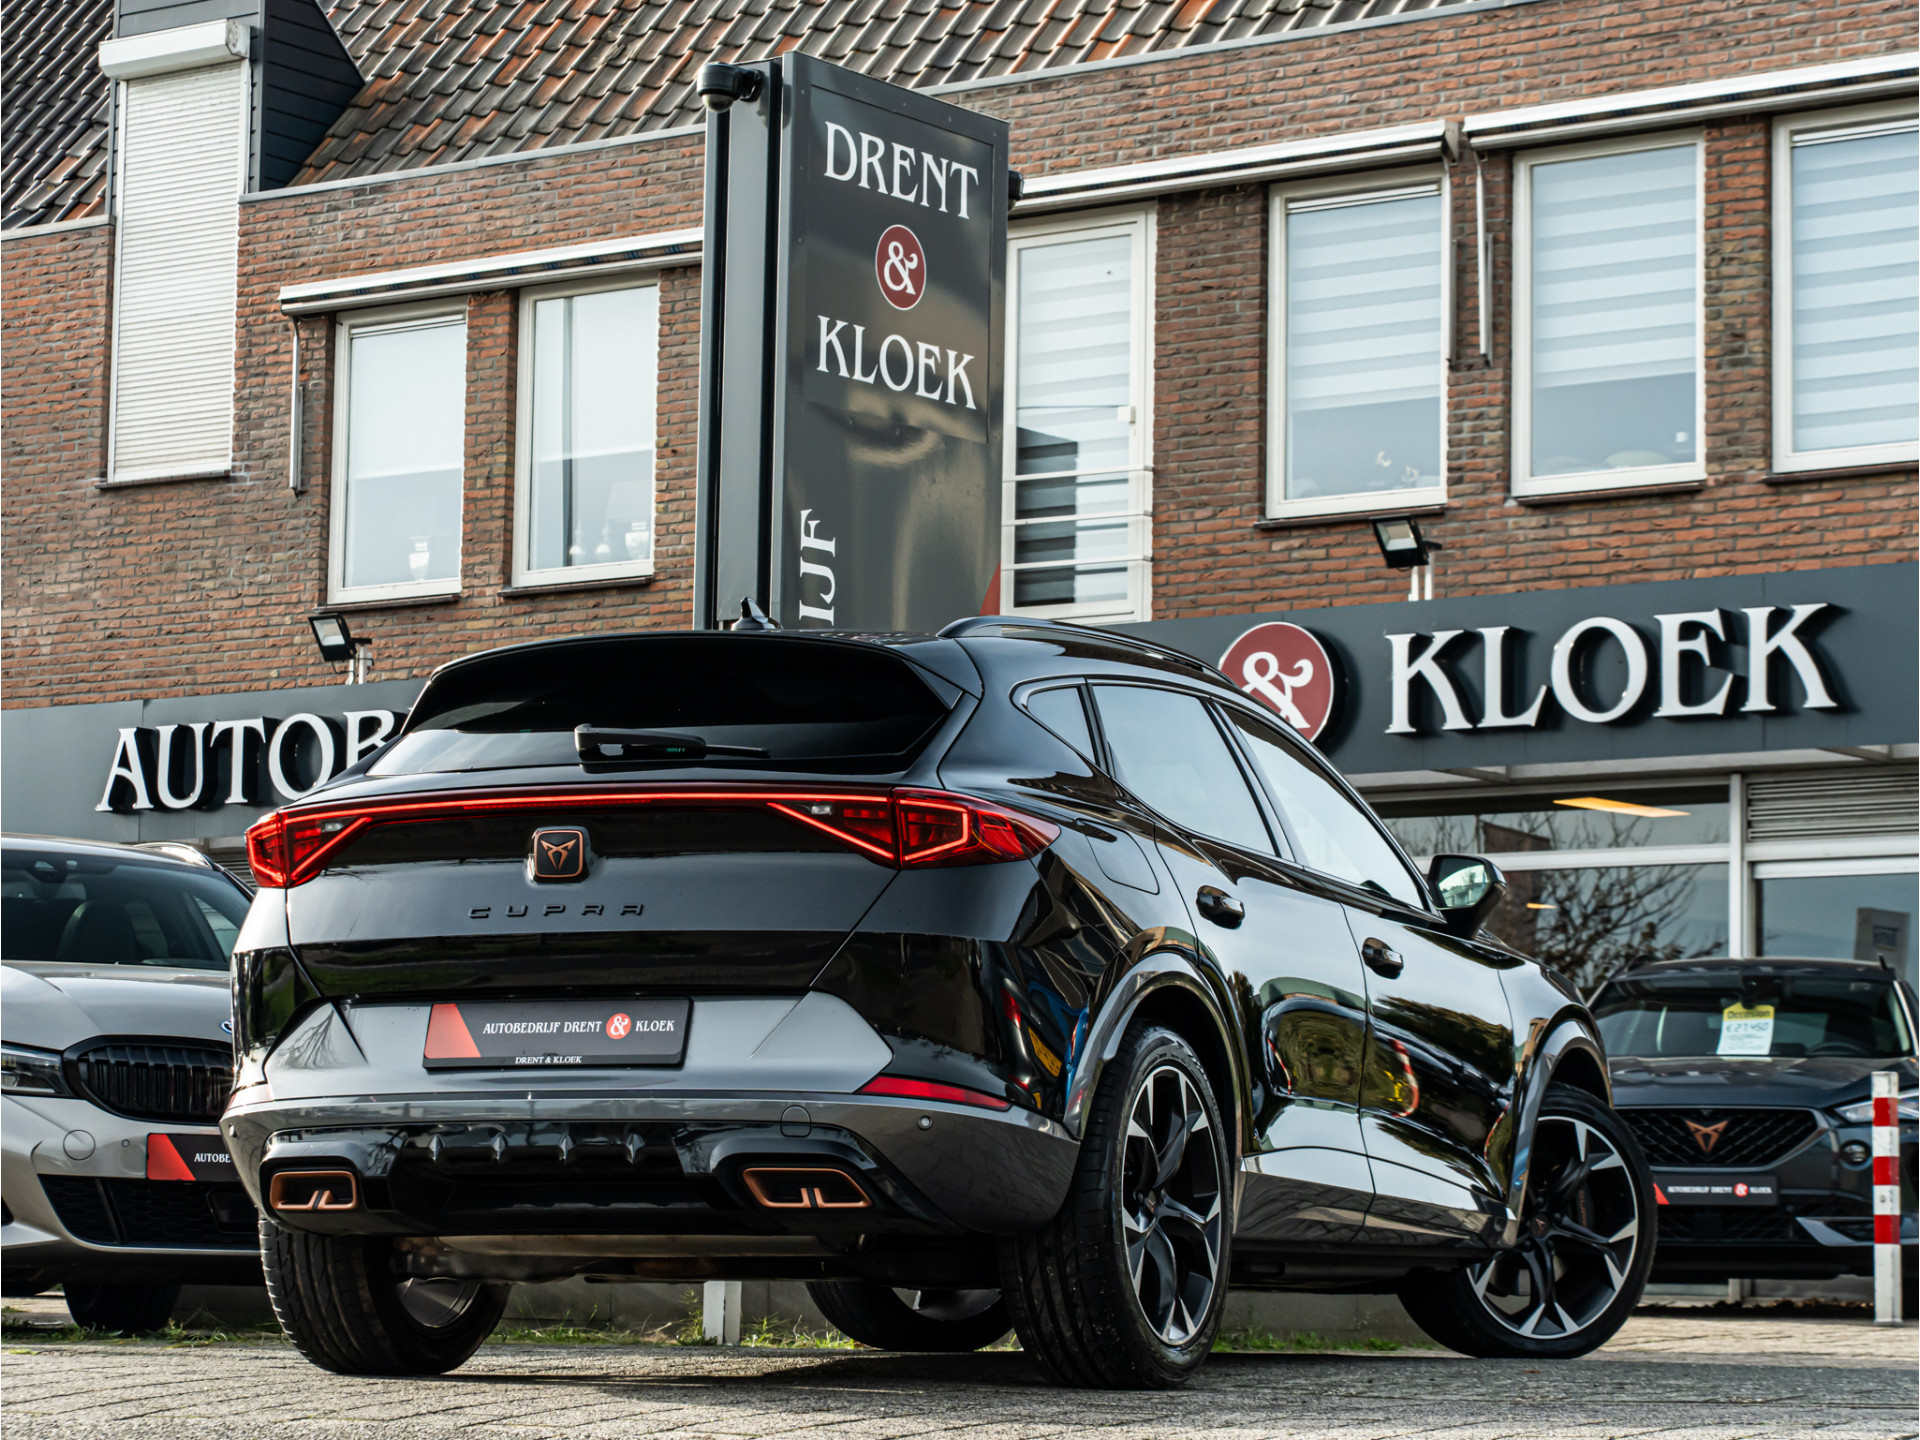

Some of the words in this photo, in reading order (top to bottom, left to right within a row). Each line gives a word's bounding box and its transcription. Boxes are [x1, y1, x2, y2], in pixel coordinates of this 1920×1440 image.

[824, 121, 979, 220] DRENT
[883, 241, 918, 295] &
[816, 315, 977, 410] KLOEK
[1240, 651, 1314, 730] &
[1384, 603, 1838, 735] KLOEK
[467, 903, 645, 919] CUPRA
[482, 1021, 560, 1035] AUTOBEDRIJF
[563, 1021, 603, 1034] DRENT
[610, 1015, 629, 1036] &
[635, 1019, 675, 1033] KLOEK
[515, 1056, 544, 1065] DRENT
[545, 1056, 552, 1064] &
[553, 1055, 583, 1064] KLOEK
